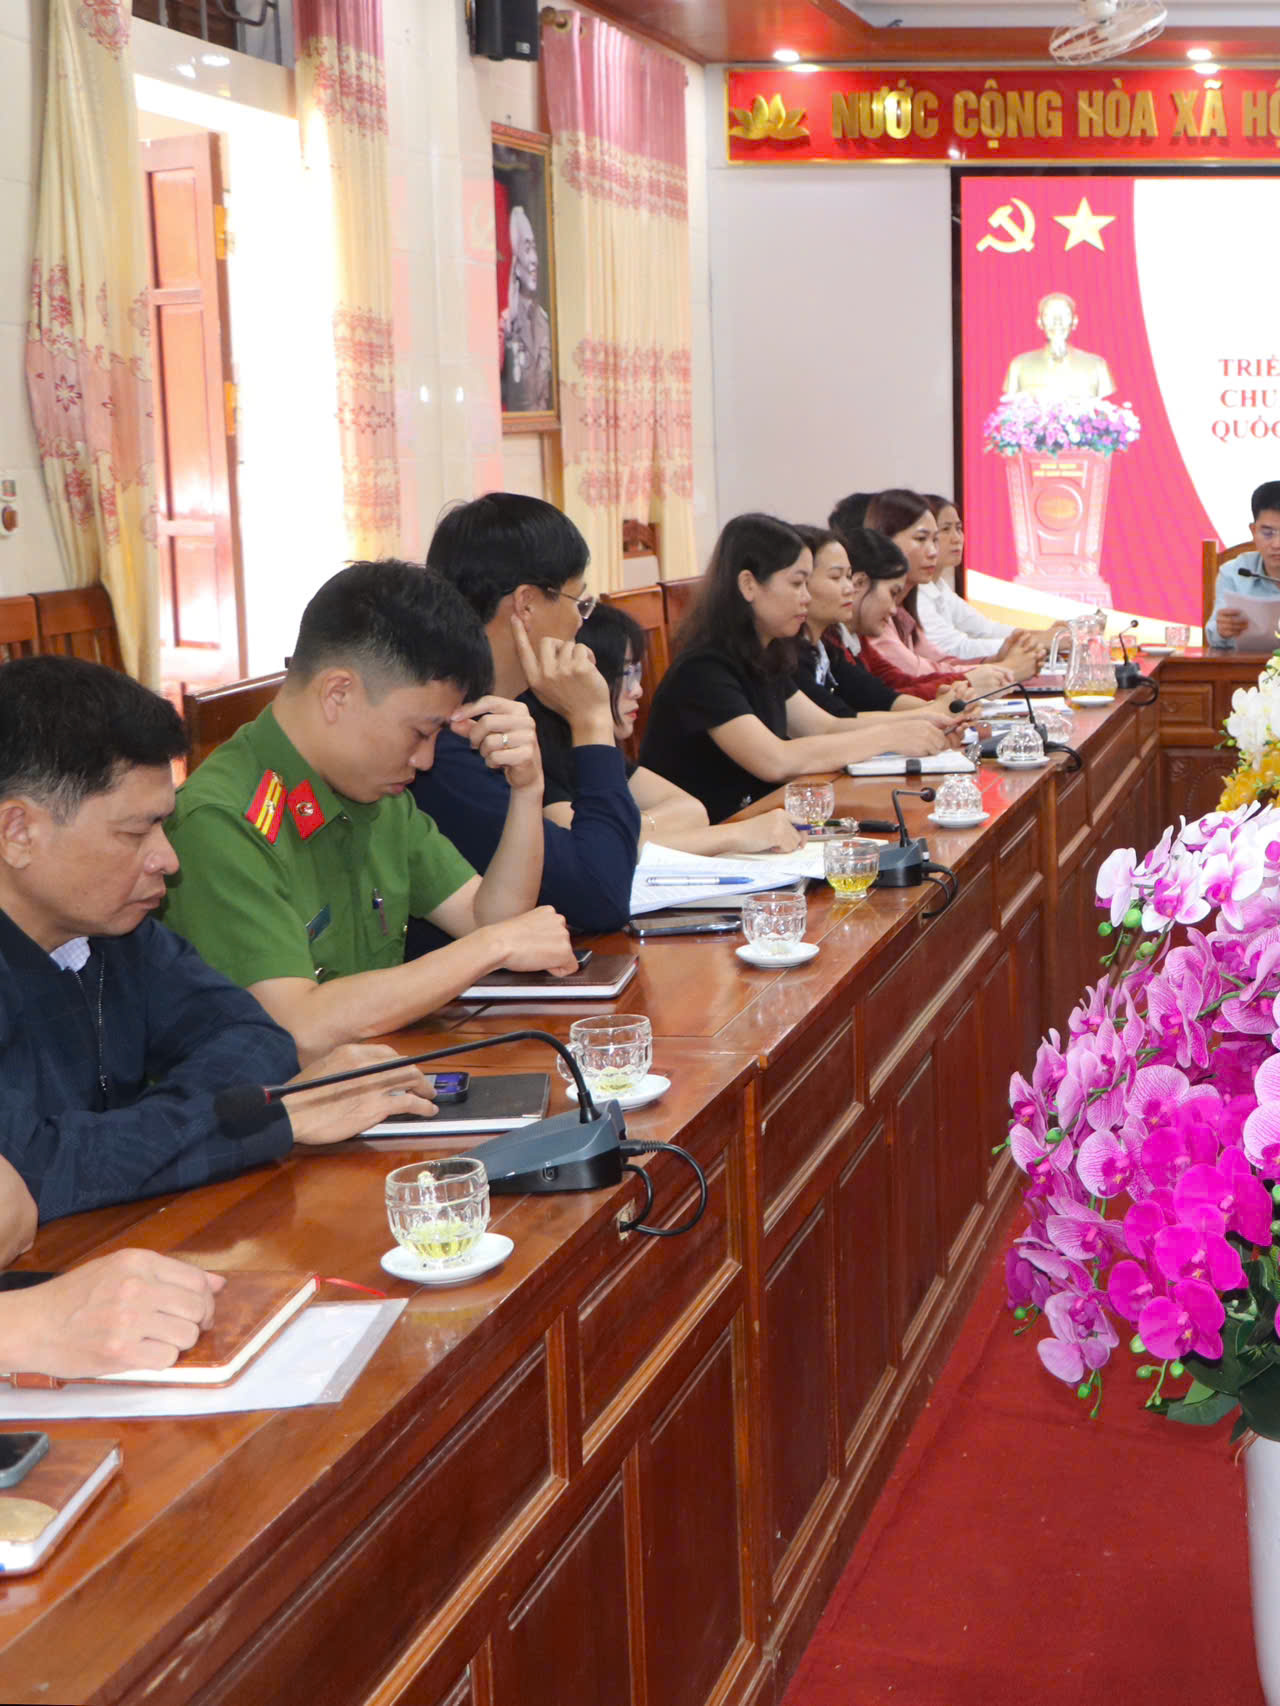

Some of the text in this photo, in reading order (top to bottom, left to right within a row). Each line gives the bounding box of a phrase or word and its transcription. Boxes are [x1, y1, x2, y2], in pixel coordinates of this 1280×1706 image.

[831, 79, 939, 139] NƯỚC
[953, 78, 1063, 148] CỘNG
[1077, 78, 1158, 138] HÒA
[1172, 79, 1228, 138] XÃ
